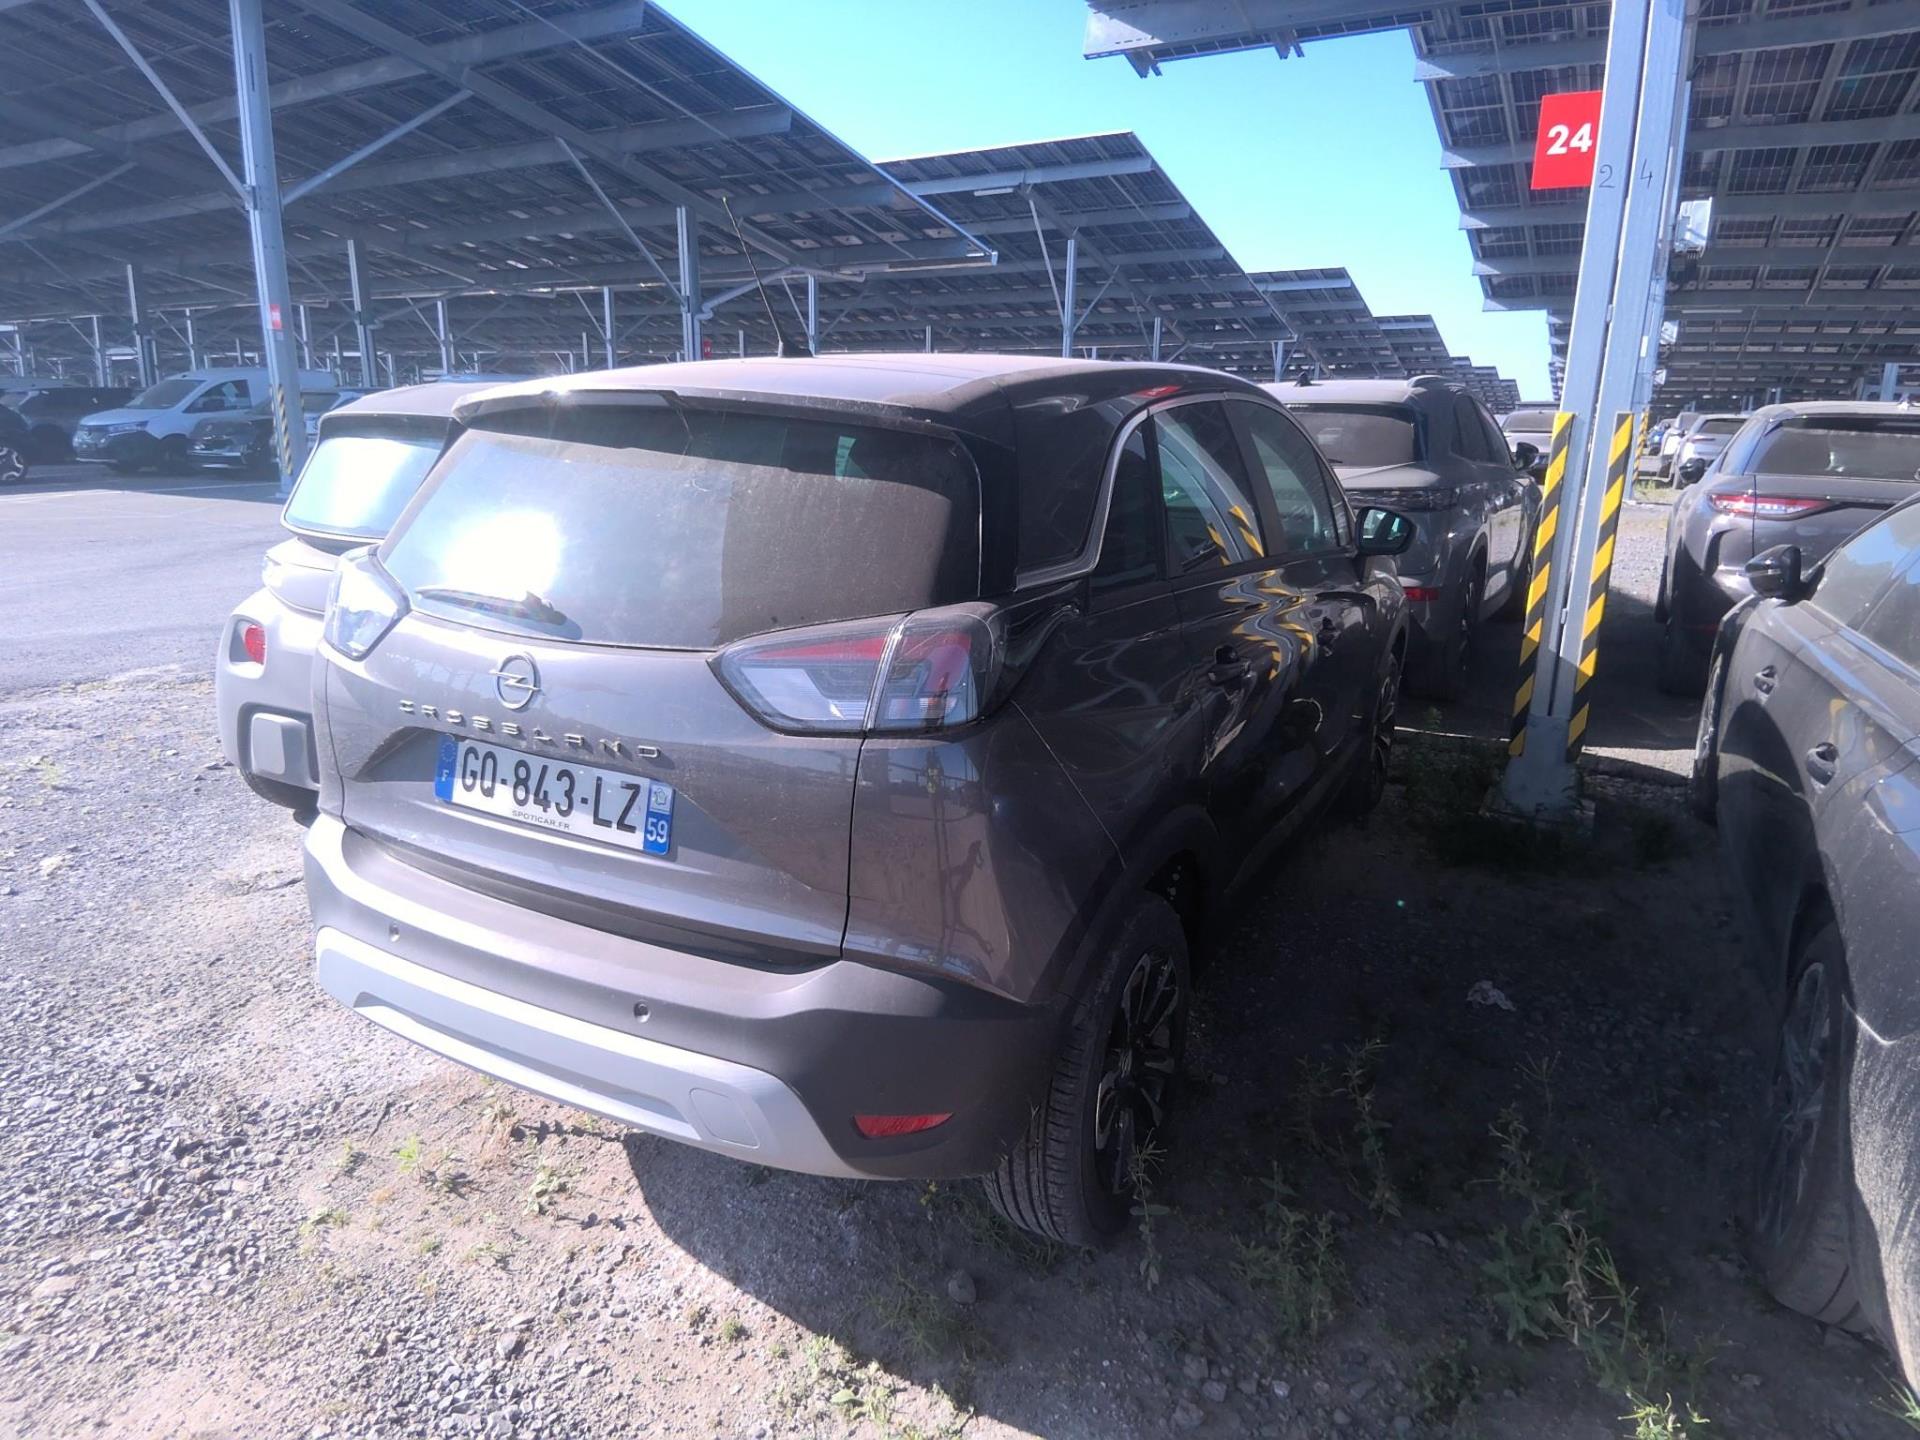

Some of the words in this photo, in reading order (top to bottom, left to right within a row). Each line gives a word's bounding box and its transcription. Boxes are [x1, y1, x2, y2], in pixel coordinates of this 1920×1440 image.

[1546, 122, 1593, 156] 24
[1599, 163, 1616, 189] 2
[1640, 158, 1654, 189] 4
[399, 699, 661, 759] CROSSLAND
[461, 746, 642, 835] GQ-843-LZ
[511, 809, 571, 831] SPOTICAR.FR
[646, 817, 668, 844] 59
